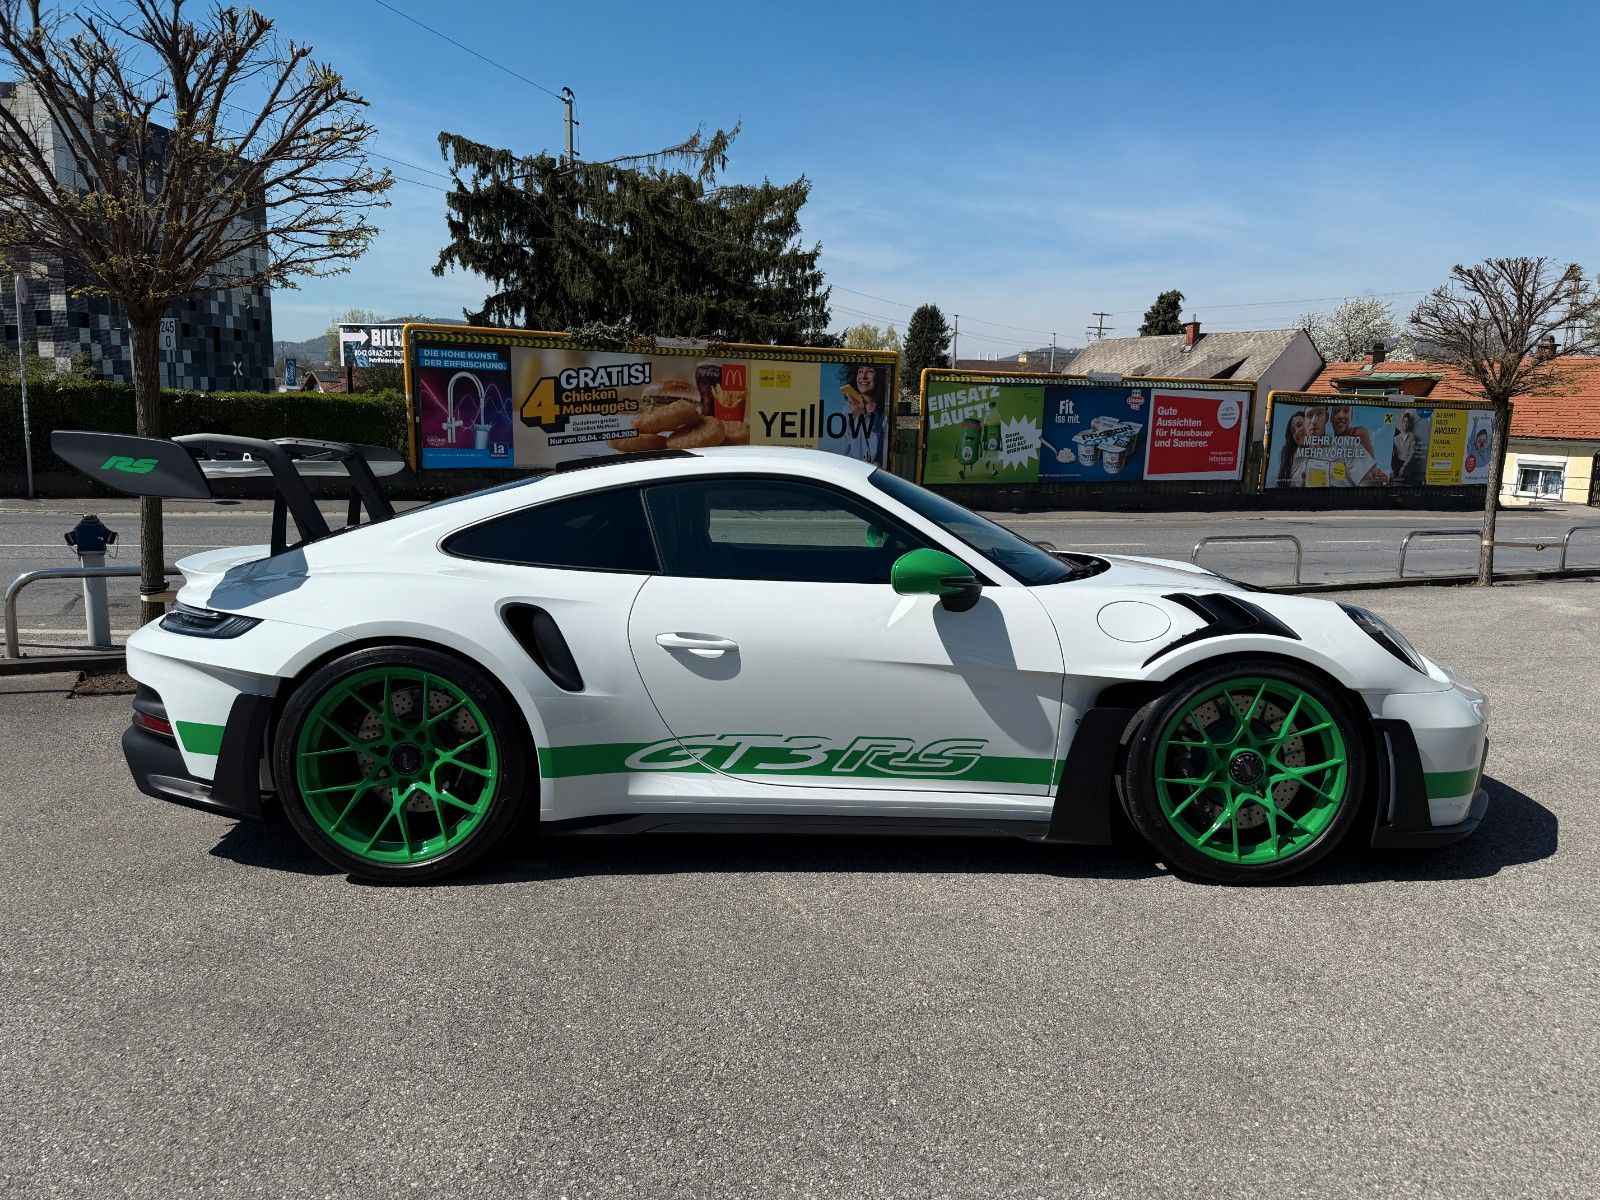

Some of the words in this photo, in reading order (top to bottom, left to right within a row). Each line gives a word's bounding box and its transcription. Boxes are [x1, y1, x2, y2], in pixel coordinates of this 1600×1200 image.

[161, 321, 174, 333] 245
[165, 335, 171, 347] 0
[371, 329, 404, 347] BILL
[423, 349, 439, 357] DIE
[440, 350, 466, 358] HOHE
[468, 352, 497, 360] KUNST
[424, 359, 442, 367] DER
[443, 360, 507, 370] ERFRISCHUNG.
[560, 363, 650, 389] GRATIS!
[522, 378, 560, 425] 4
[561, 389, 616, 403] Chicken
[928, 385, 1000, 412] EINSATZ
[562, 400, 639, 415] McNuggets
[1059, 399, 1074, 415] Fit
[1157, 406, 1178, 416] Gute
[1055, 413, 1065, 424] iss
[1067, 413, 1081, 424] mit.
[1156, 417, 1202, 427] Aussichten
[1155, 428, 1168, 437] für
[1169, 428, 1214, 437] Hausbauer
[549, 436, 564, 445] Nur
[564, 435, 577, 444] von
[1154, 438, 1170, 447] und
[1172, 438, 1208, 448] Sanierer.
[1303, 435, 1330, 446] MEHR
[1331, 436, 1363, 446] KONTO.
[1296, 447, 1322, 458] MEHR
[1325, 447, 1367, 458] VORTEILE.
[100, 455, 160, 474] RS
